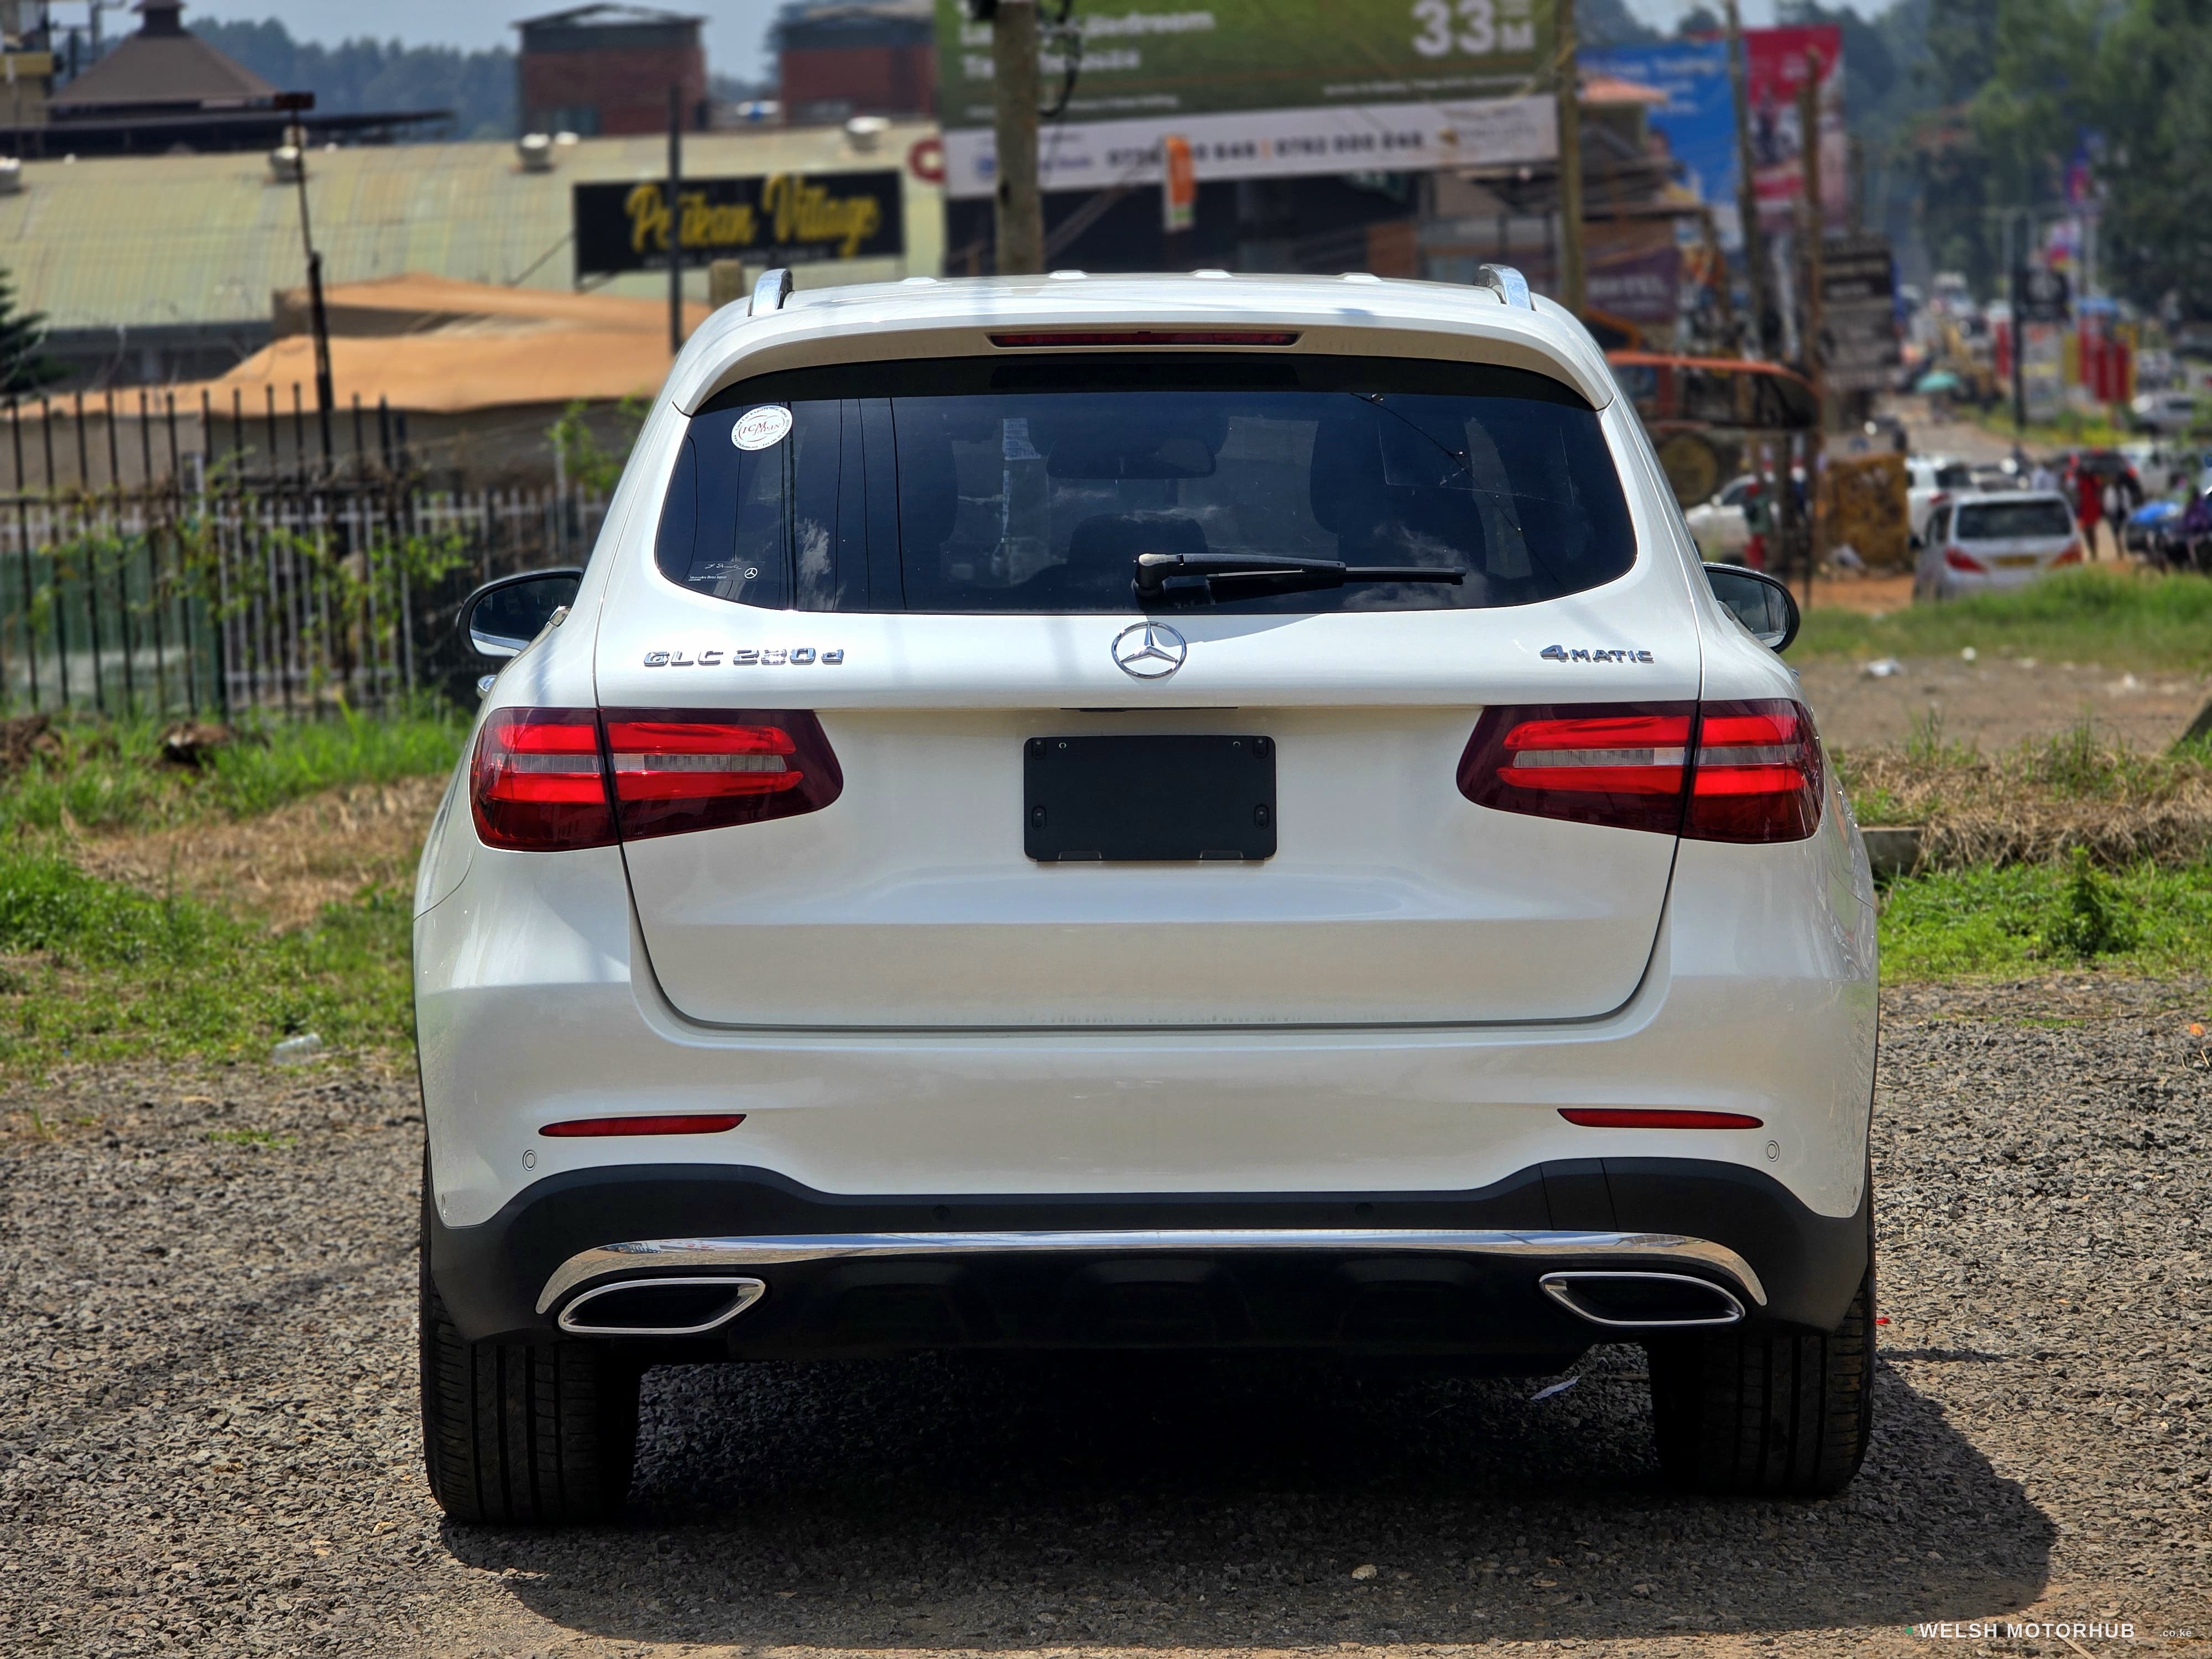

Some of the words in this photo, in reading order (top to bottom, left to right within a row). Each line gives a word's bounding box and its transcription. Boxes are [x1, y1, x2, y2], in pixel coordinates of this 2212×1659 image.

[1411, 0, 1496, 55] 33
[644, 651, 723, 666] GLC
[1540, 645, 1655, 664] 4MATIC
